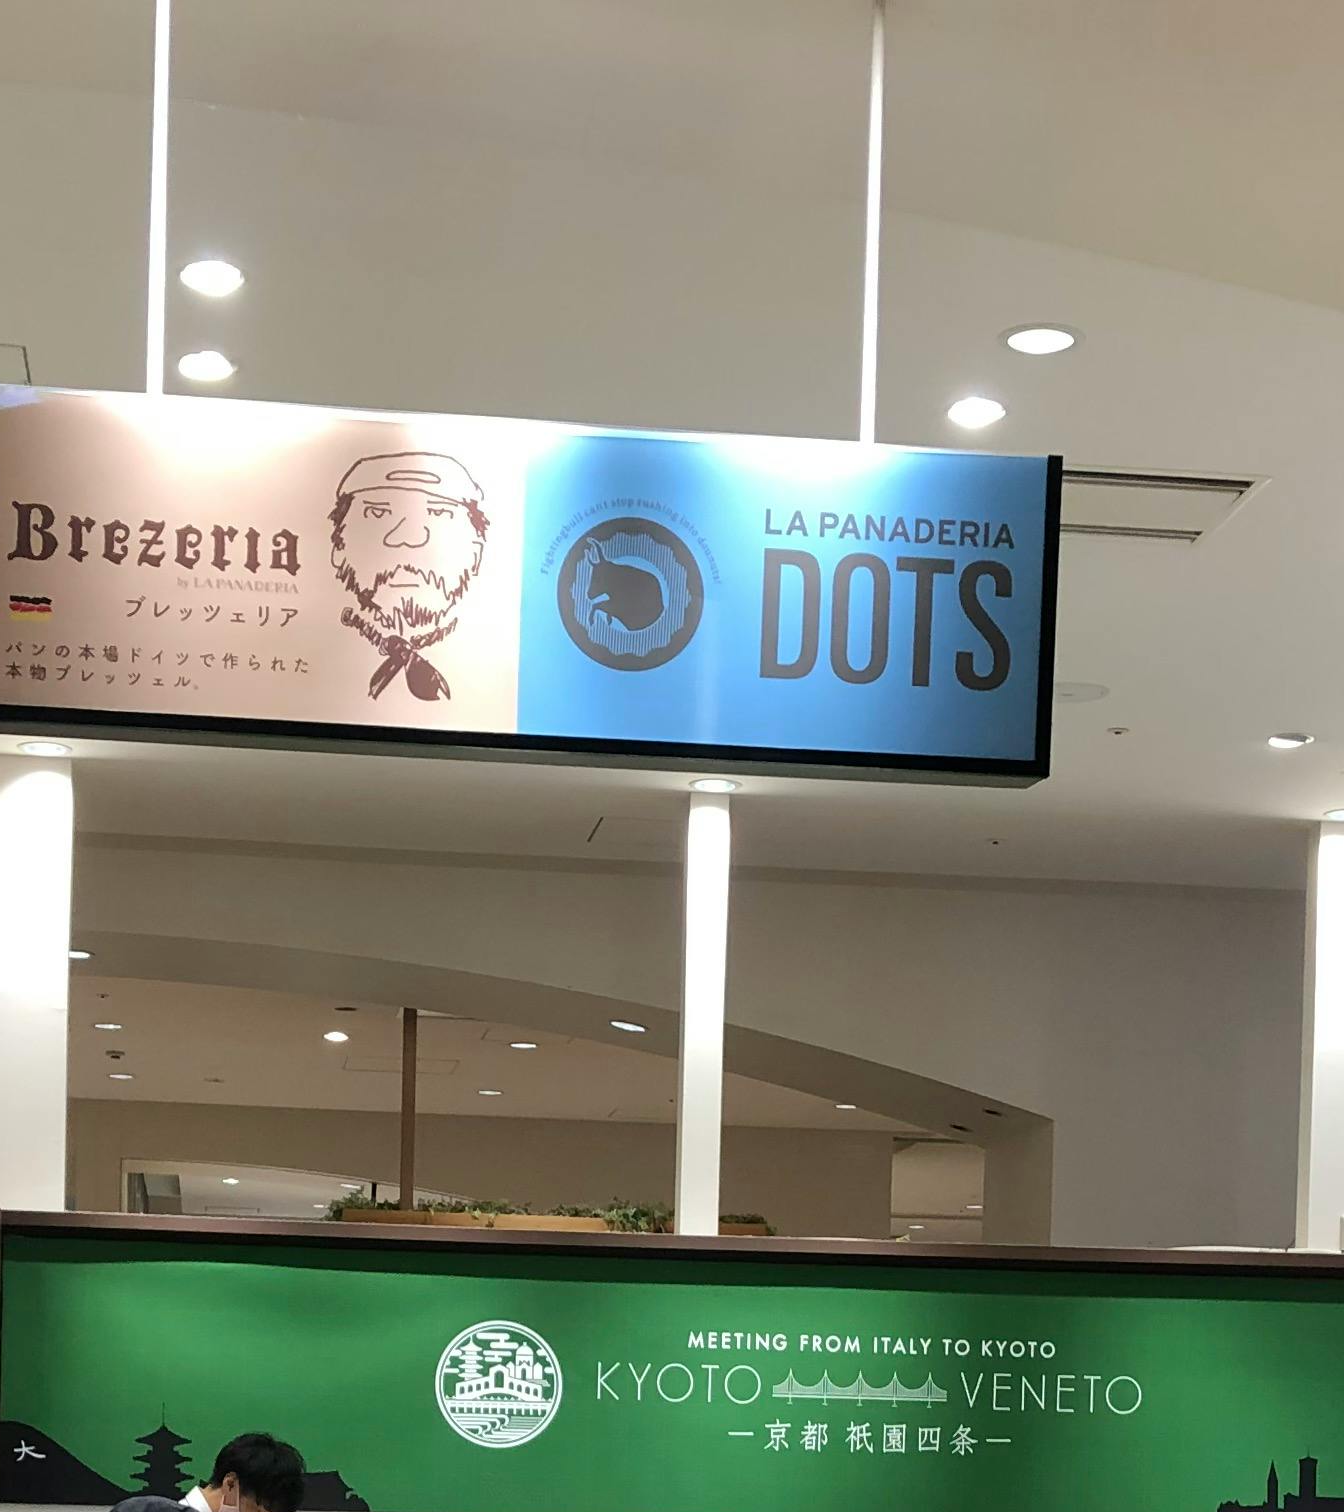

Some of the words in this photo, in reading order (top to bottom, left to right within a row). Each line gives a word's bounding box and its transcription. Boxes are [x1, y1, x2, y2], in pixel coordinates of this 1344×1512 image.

[7, 500, 302, 577] Brezeria
[763, 508, 809, 538] LA
[819, 511, 1015, 549] PANADERIA
[194, 577, 214, 589] LA
[216, 579, 299, 595] PANADERIA
[125, 595, 299, 628] ブレッツェリア
[760, 547, 1013, 691] DOTS
[6, 641, 308, 674] パンの本場ドイツで作られた
[688, 1330, 790, 1353] MEETING
[799, 1333, 862, 1354] FROM
[872, 1335, 934, 1356] ITALY
[942, 1337, 970, 1357] TO
[980, 1338, 1057, 1359] KYOTO
[596, 1361, 762, 1405] KYOTO
[961, 1371, 1143, 1415] VENETO
[764, 1418, 828, 1452] 京都
